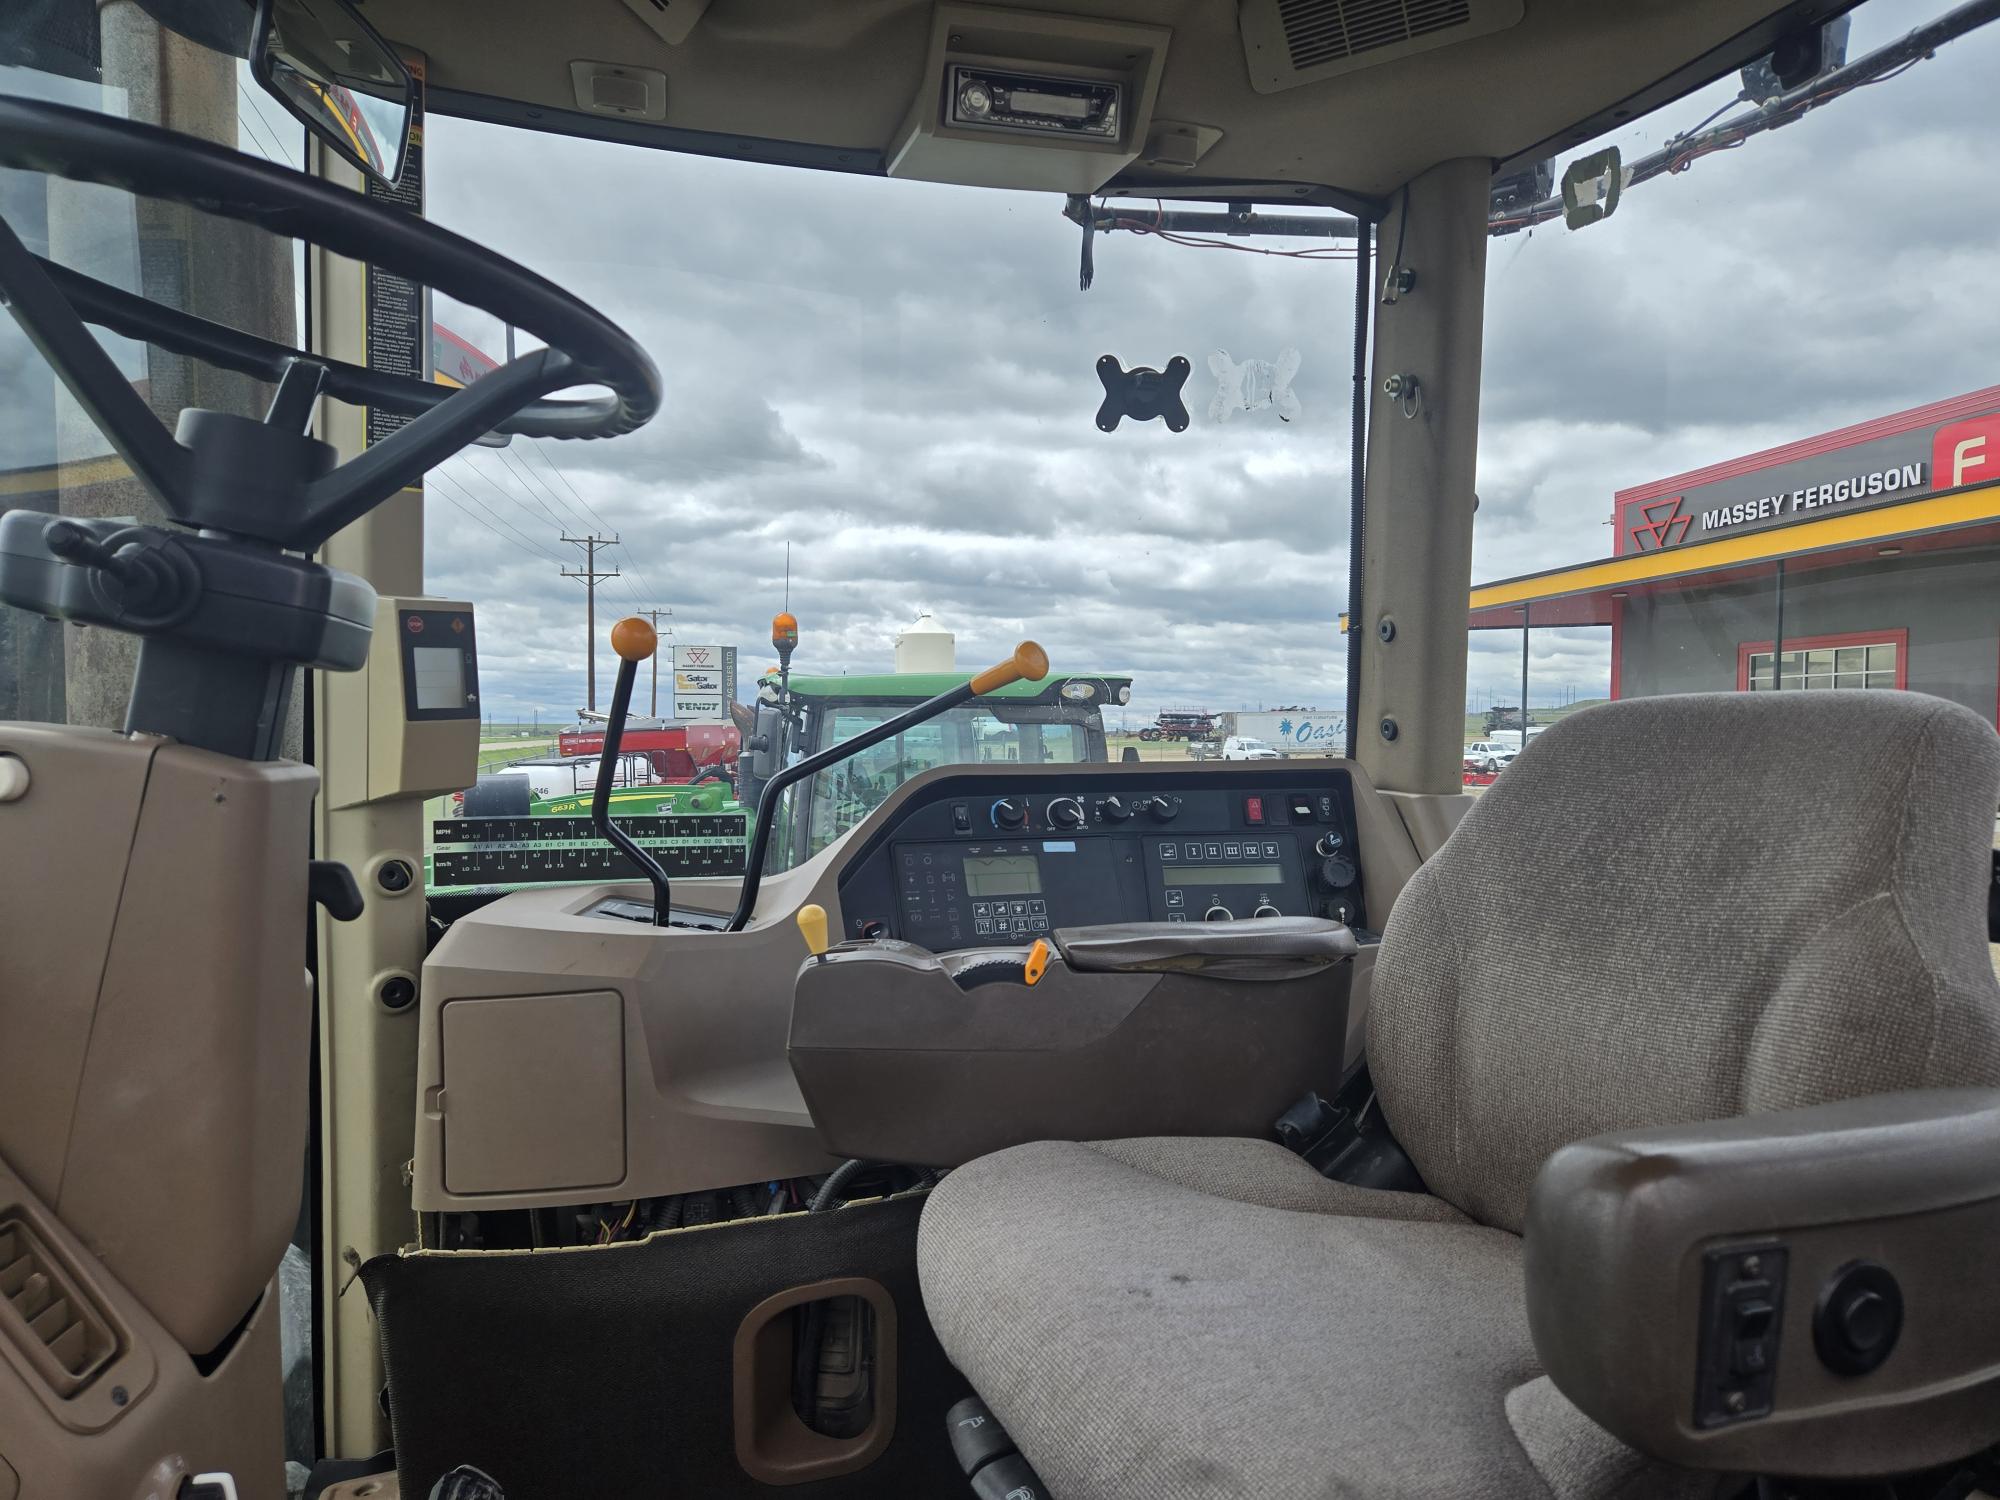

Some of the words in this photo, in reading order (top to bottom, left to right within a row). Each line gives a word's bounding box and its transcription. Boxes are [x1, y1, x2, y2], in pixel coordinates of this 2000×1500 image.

[1702, 493, 1785, 531] MASSEY
[1792, 461, 1922, 512] FERGUSON
[677, 702, 720, 711] FENDT
[1296, 719, 1347, 743] Oasi
[1245, 846, 1257, 855] IV
